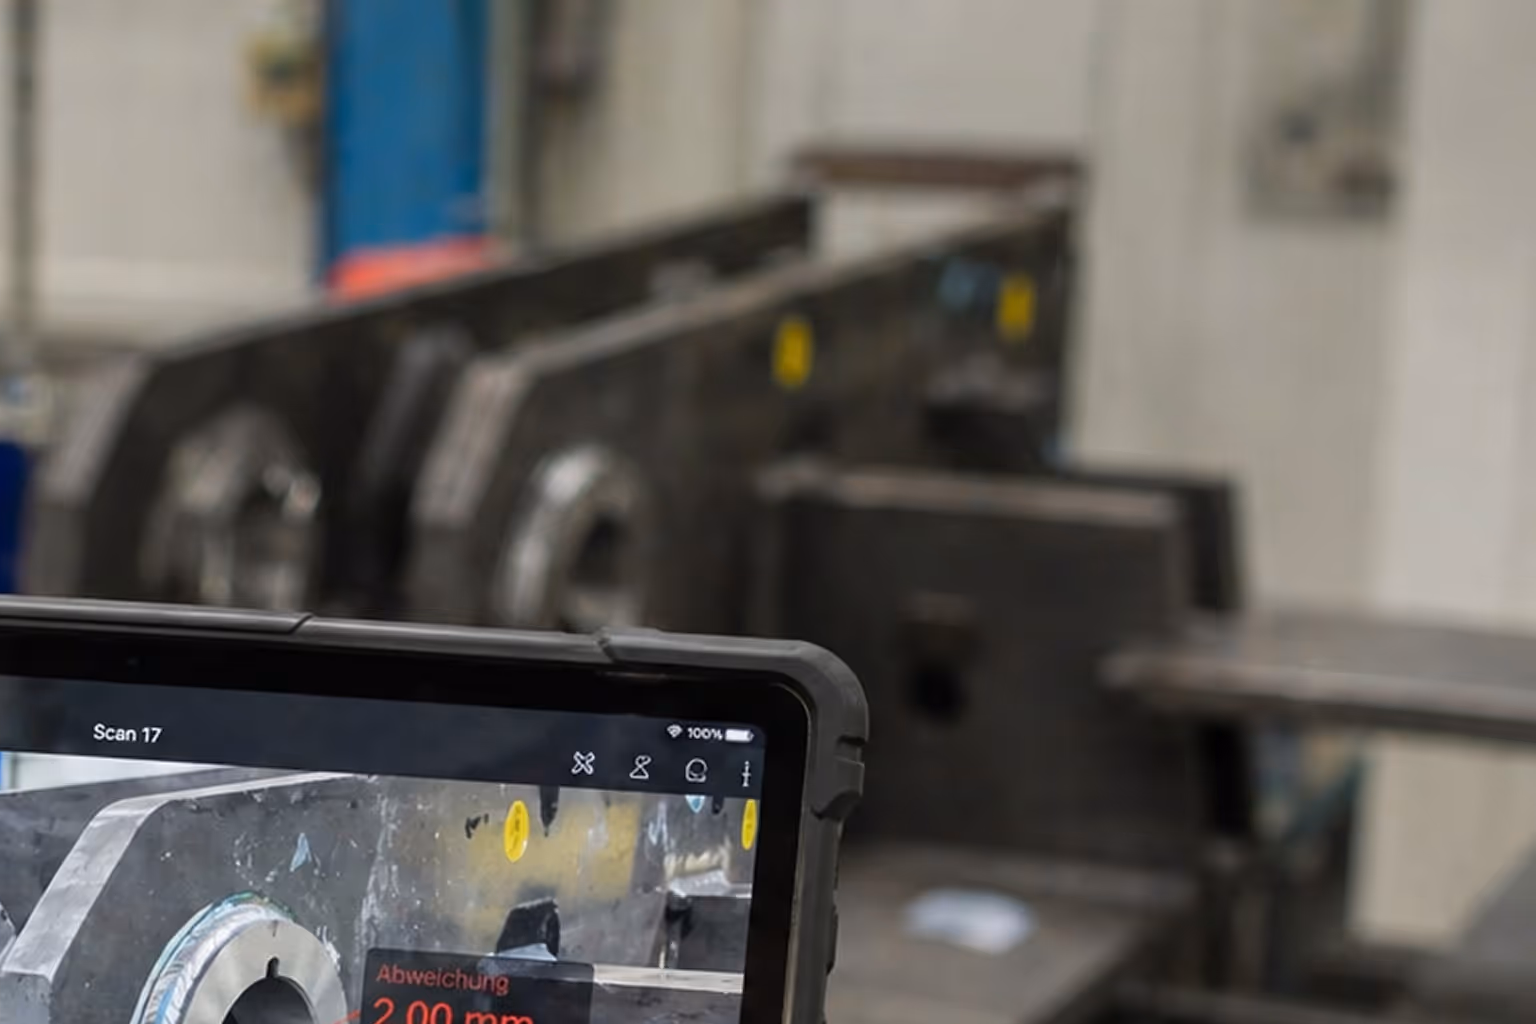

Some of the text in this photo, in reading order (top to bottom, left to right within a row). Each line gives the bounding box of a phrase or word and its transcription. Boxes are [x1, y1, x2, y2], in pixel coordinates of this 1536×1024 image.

[93, 723, 163, 743] Scan 17
[687, 727, 723, 741] 100%
[375, 963, 510, 996] Abweichung
